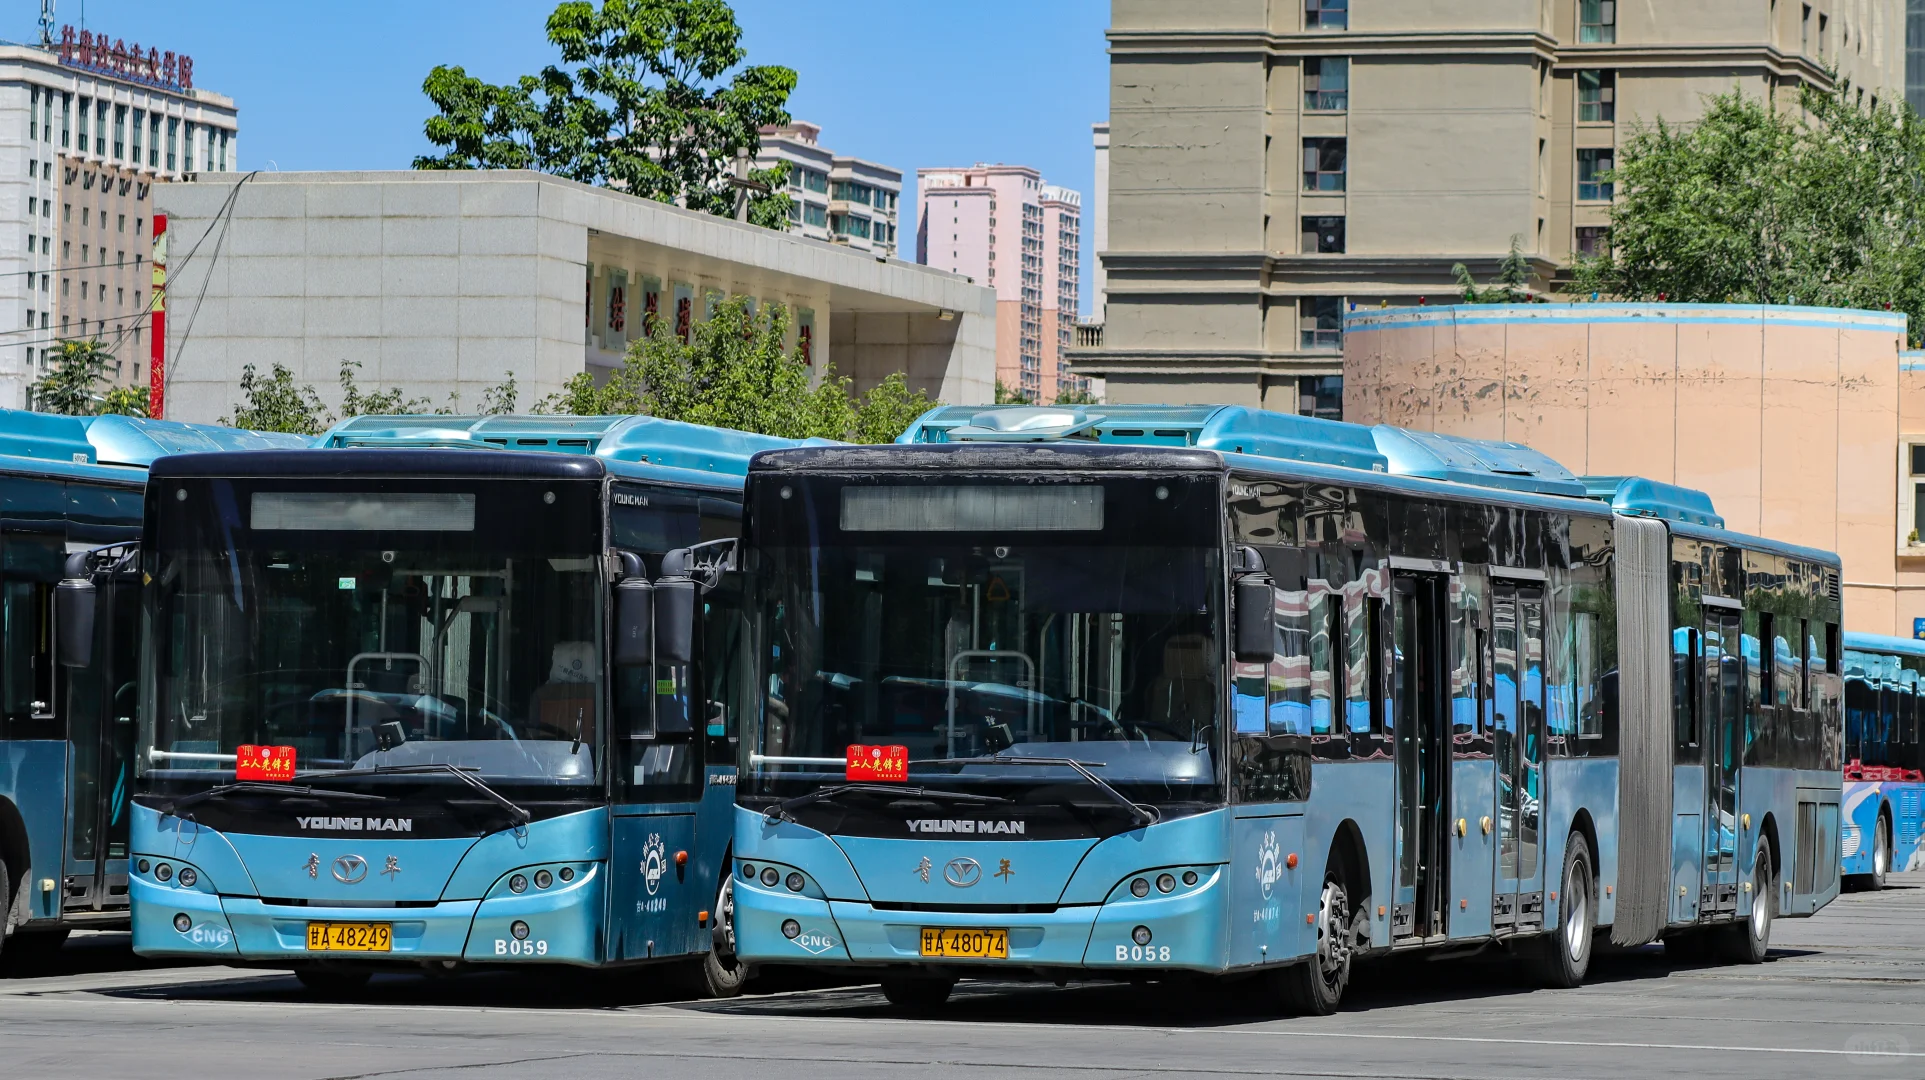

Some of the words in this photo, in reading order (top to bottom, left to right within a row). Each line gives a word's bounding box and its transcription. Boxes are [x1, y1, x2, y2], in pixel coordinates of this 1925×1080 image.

[61, 24, 194, 89] 甘肃社会主义学院
[613, 493, 635, 505] YOUNG
[634, 495, 649, 506] MAN
[240, 757, 291, 772] 工人先锋号
[850, 757, 903, 772] 工人先锋号
[296, 816, 363, 831] YOUNG
[366, 818, 412, 832] MAN
[906, 819, 975, 833] YOUNG
[978, 821, 1025, 834] MAN
[192, 930, 229, 943] CNG
[800, 934, 831, 947] CNG
[495, 939, 548, 955] B059
[1115, 945, 1171, 961] B058
